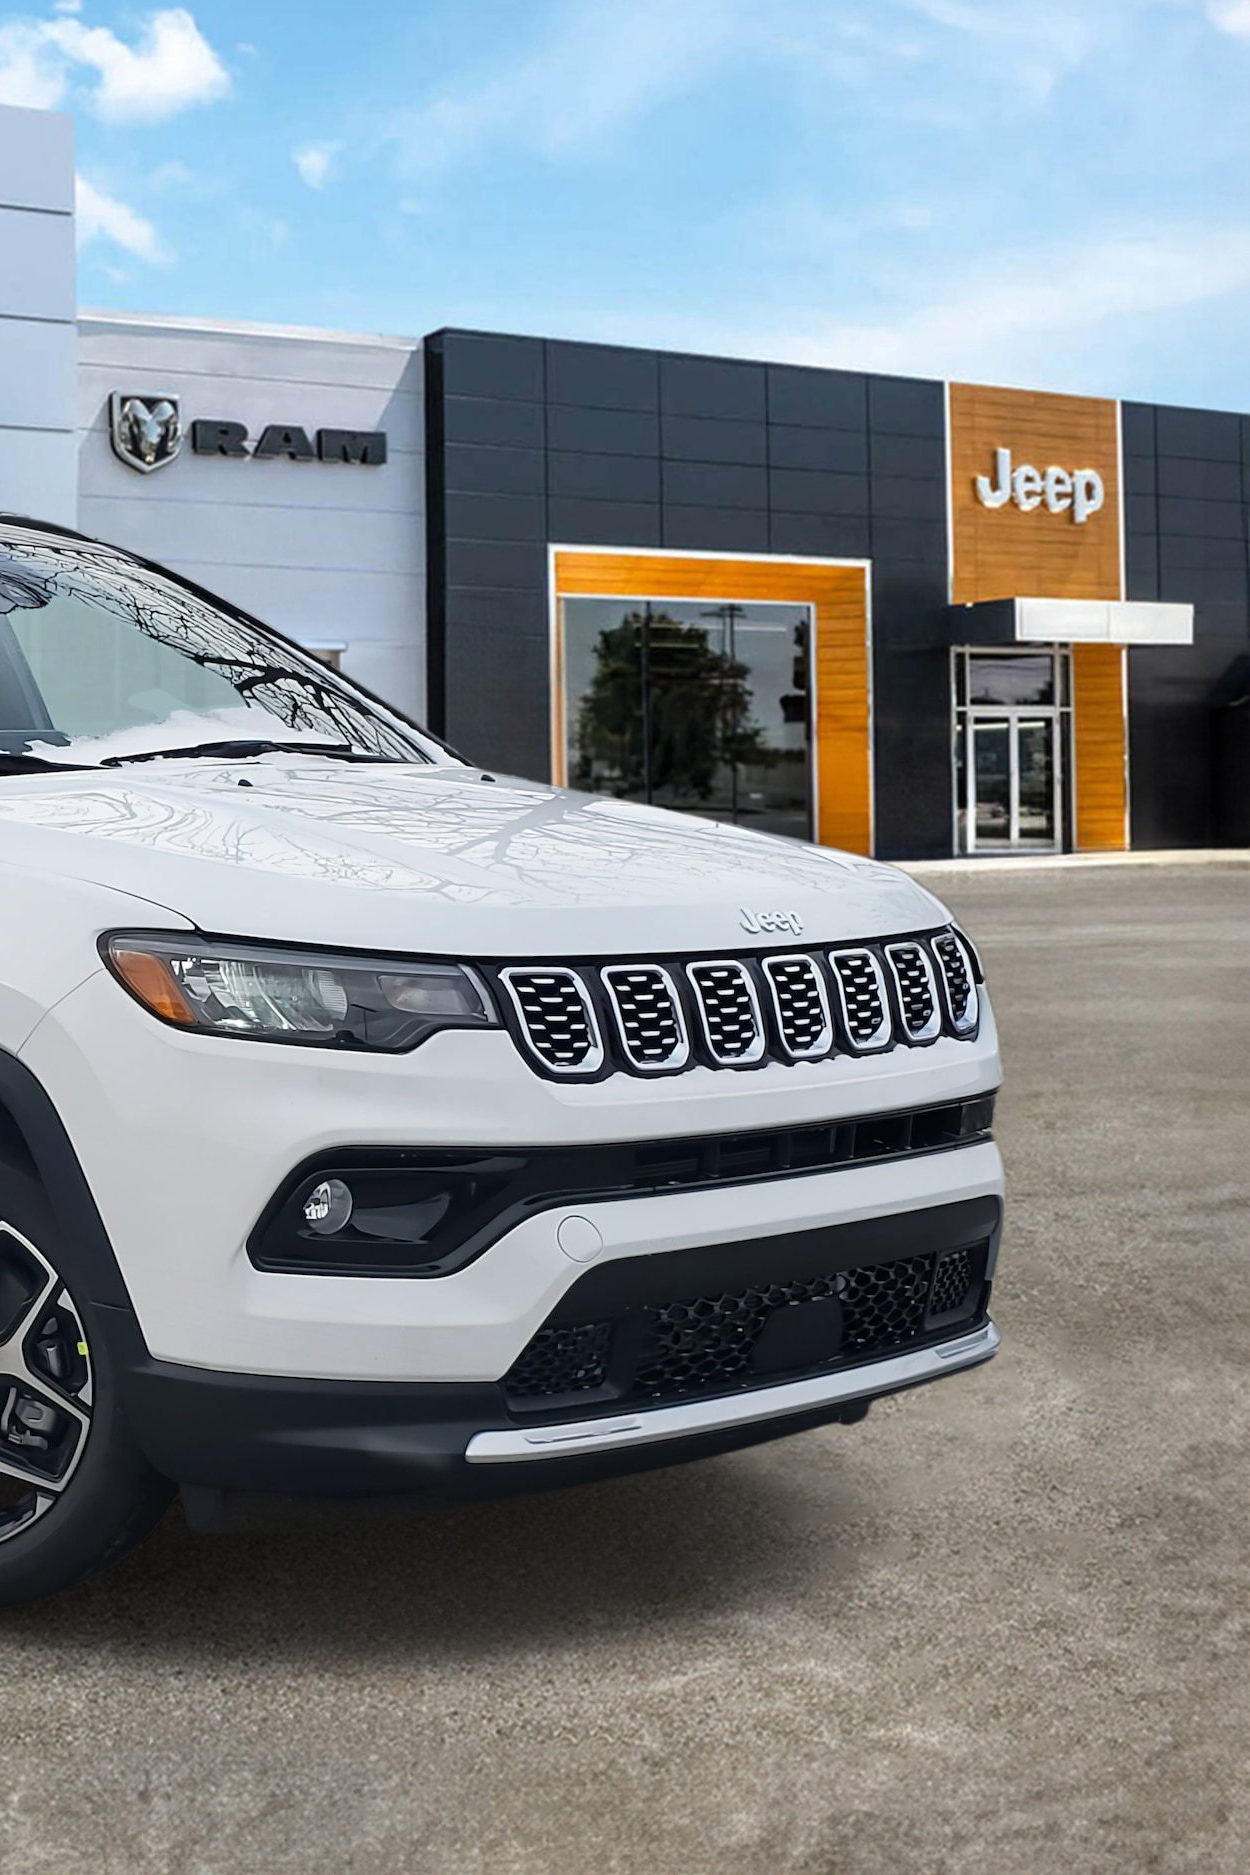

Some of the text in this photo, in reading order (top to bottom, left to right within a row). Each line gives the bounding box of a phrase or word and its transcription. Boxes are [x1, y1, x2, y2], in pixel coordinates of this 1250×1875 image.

[191, 418, 388, 465] RAM
[976, 447, 1104, 524] Jeep
[738, 907, 804, 936] Jeep
